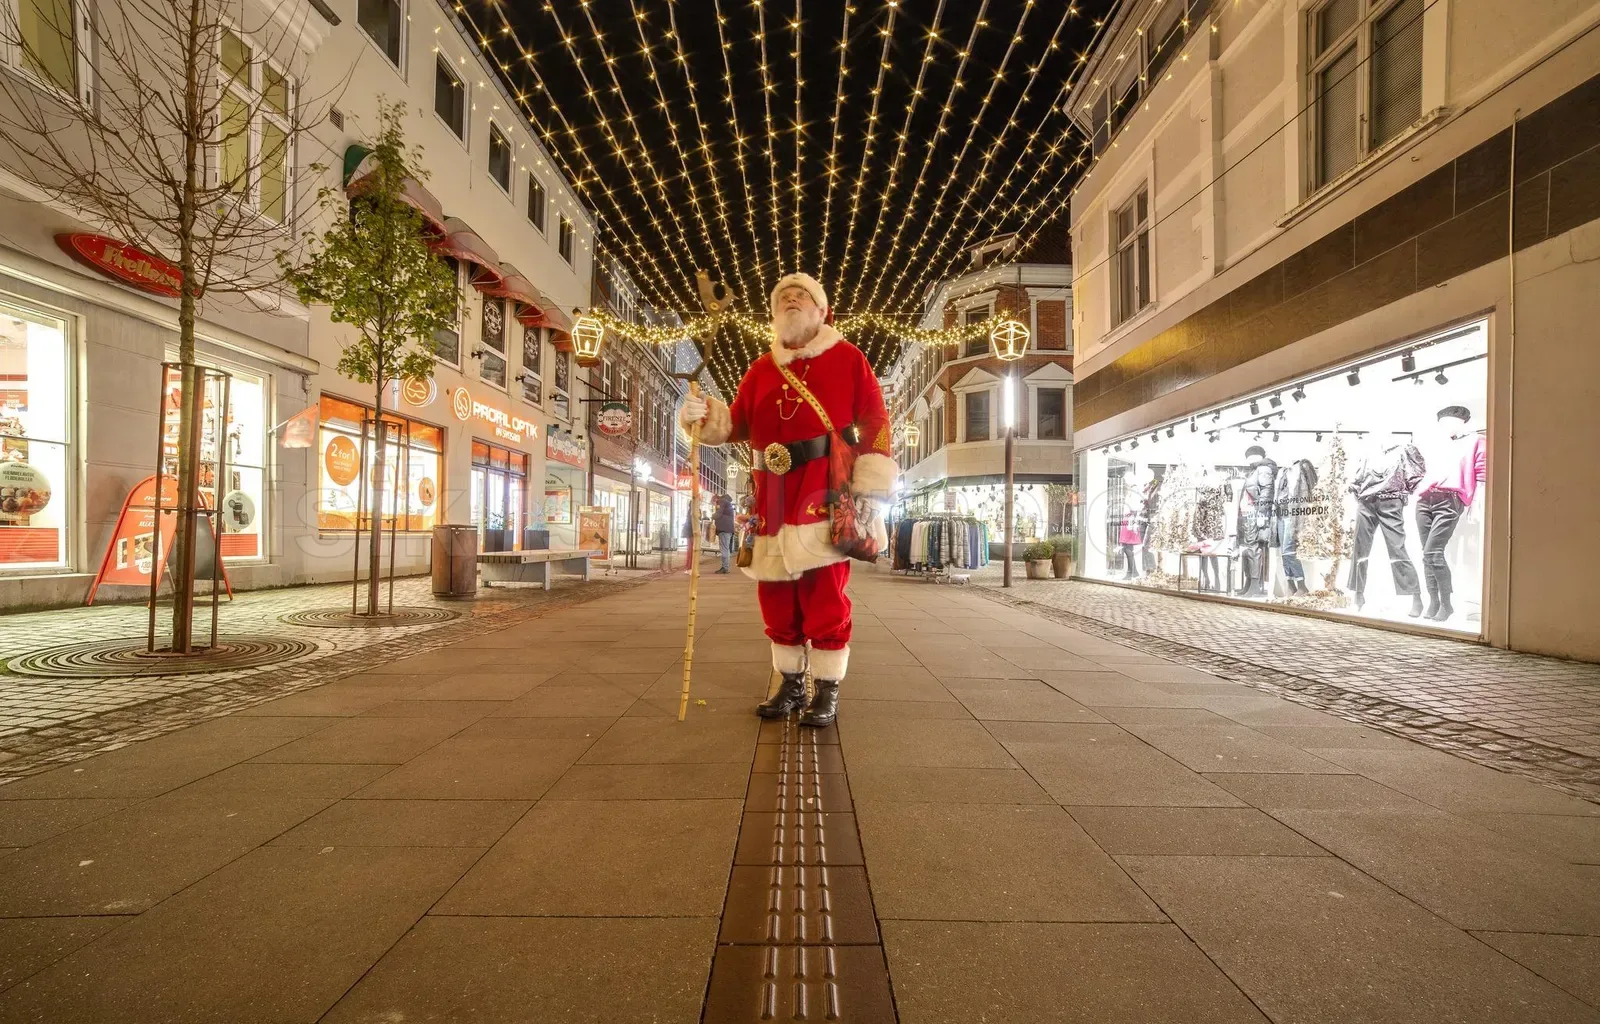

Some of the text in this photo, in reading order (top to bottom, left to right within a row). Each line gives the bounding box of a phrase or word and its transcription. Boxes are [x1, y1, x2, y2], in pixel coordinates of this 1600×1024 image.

[473, 401, 538, 438] PROFIL OPTIK
[331, 443, 355, 461] 2 for 1
[583, 518, 589, 527] 2
